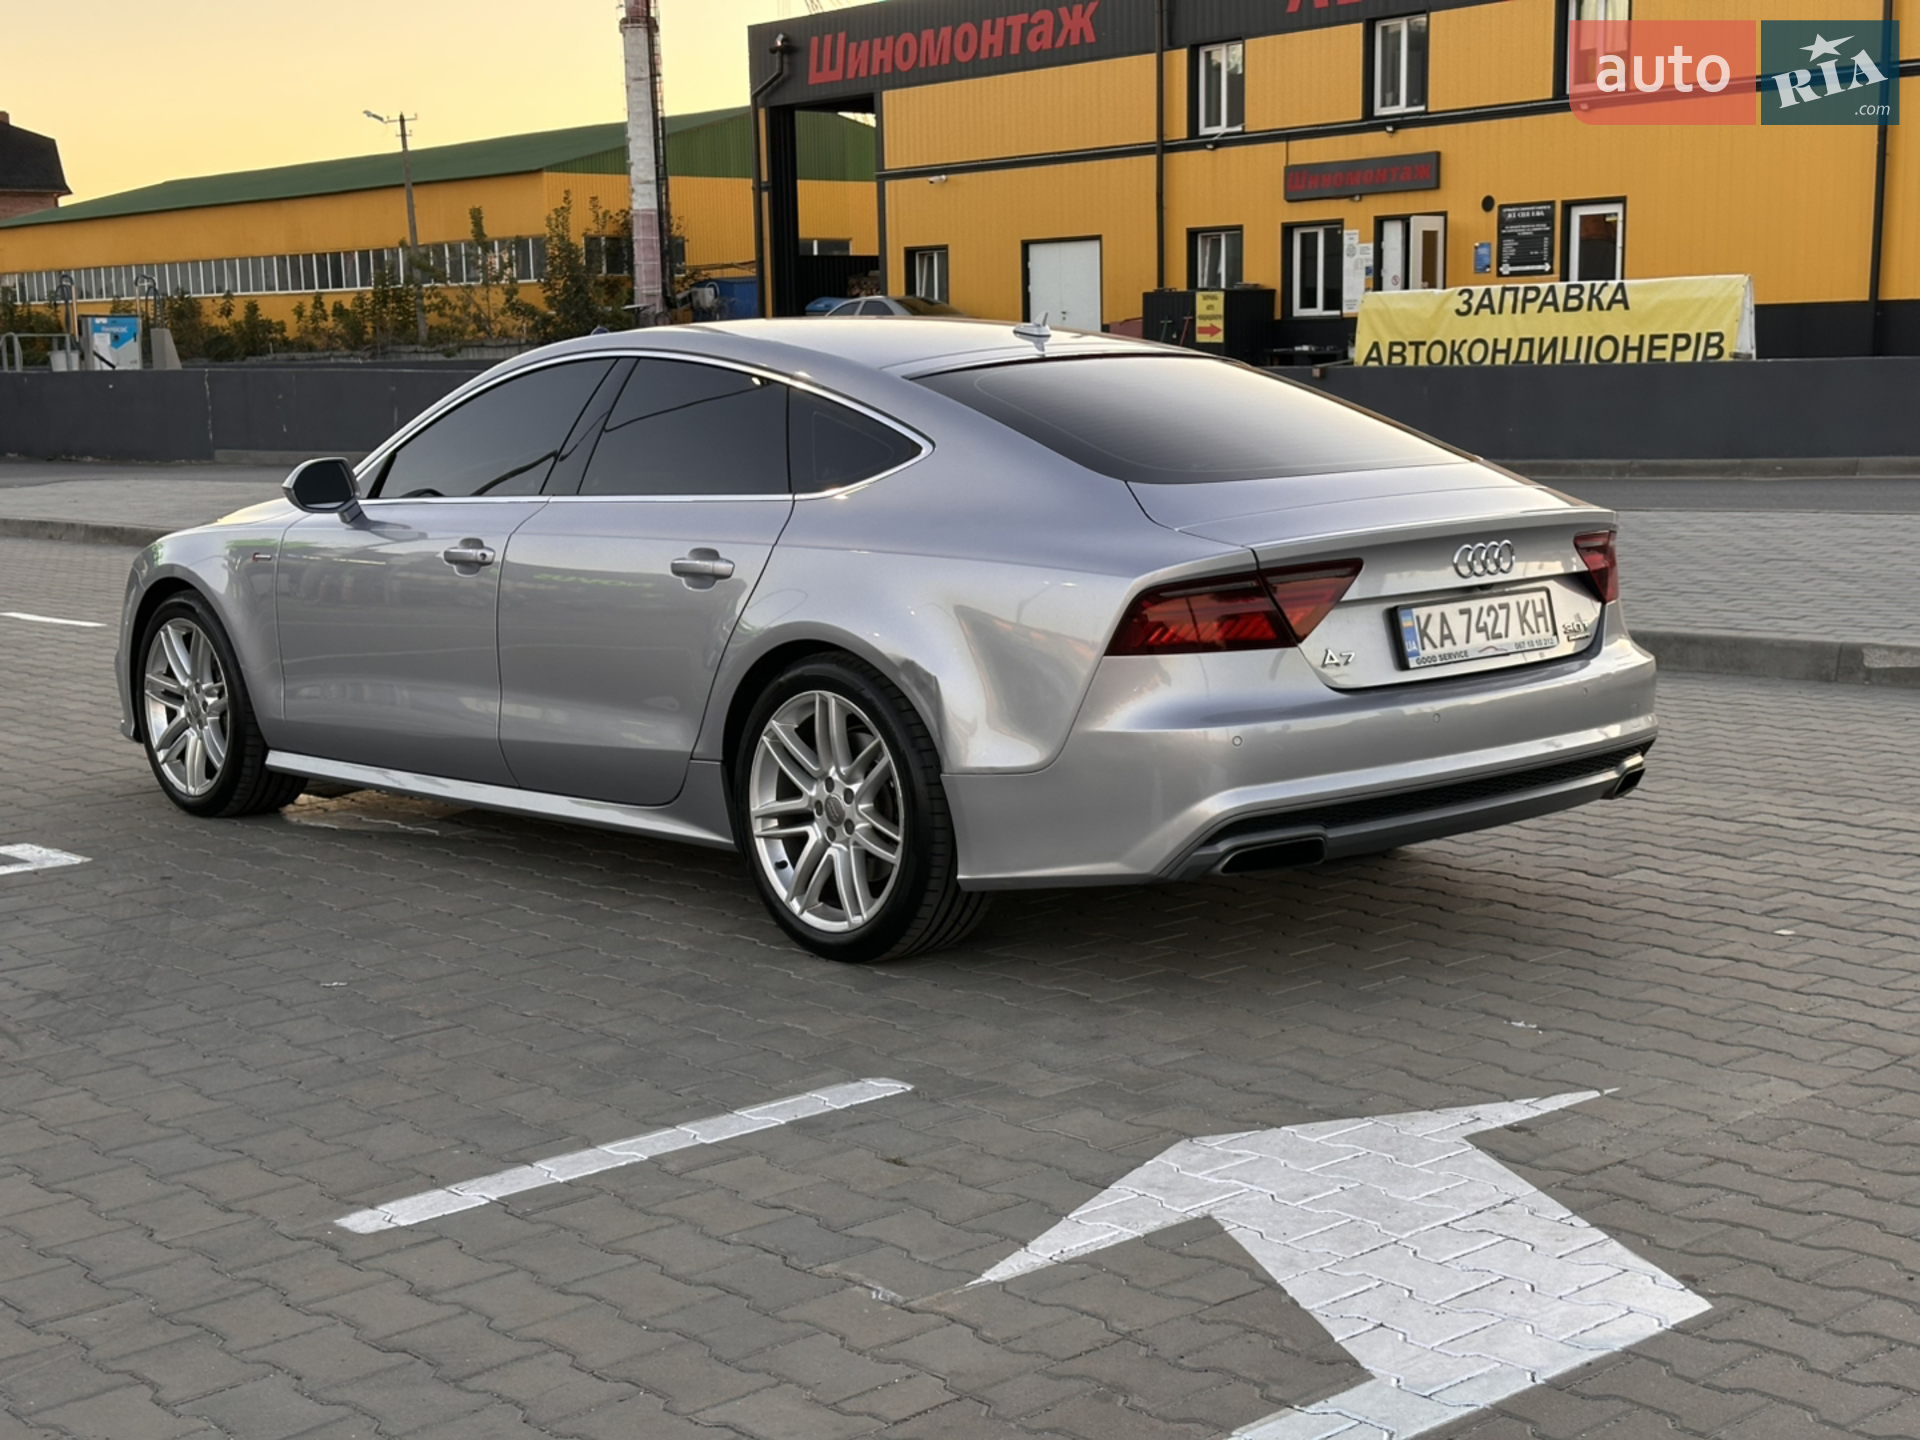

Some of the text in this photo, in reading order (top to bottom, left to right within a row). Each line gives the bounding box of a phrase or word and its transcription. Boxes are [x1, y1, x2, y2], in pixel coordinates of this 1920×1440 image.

[808, 1, 1099, 85] Шиномонтаж
[1287, 162, 1432, 192] Шиномонтаж
[1454, 281, 1631, 318] ЗАПРАВКА
[1362, 330, 1726, 366] АВТОКОНДИЦІОНЕРІВ
[1415, 597, 1550, 651] KA 7427 KH
[1405, 640, 1418, 652] UA
[1415, 654, 1438, 666] GOOD
[1438, 649, 1469, 662] SERVICE
